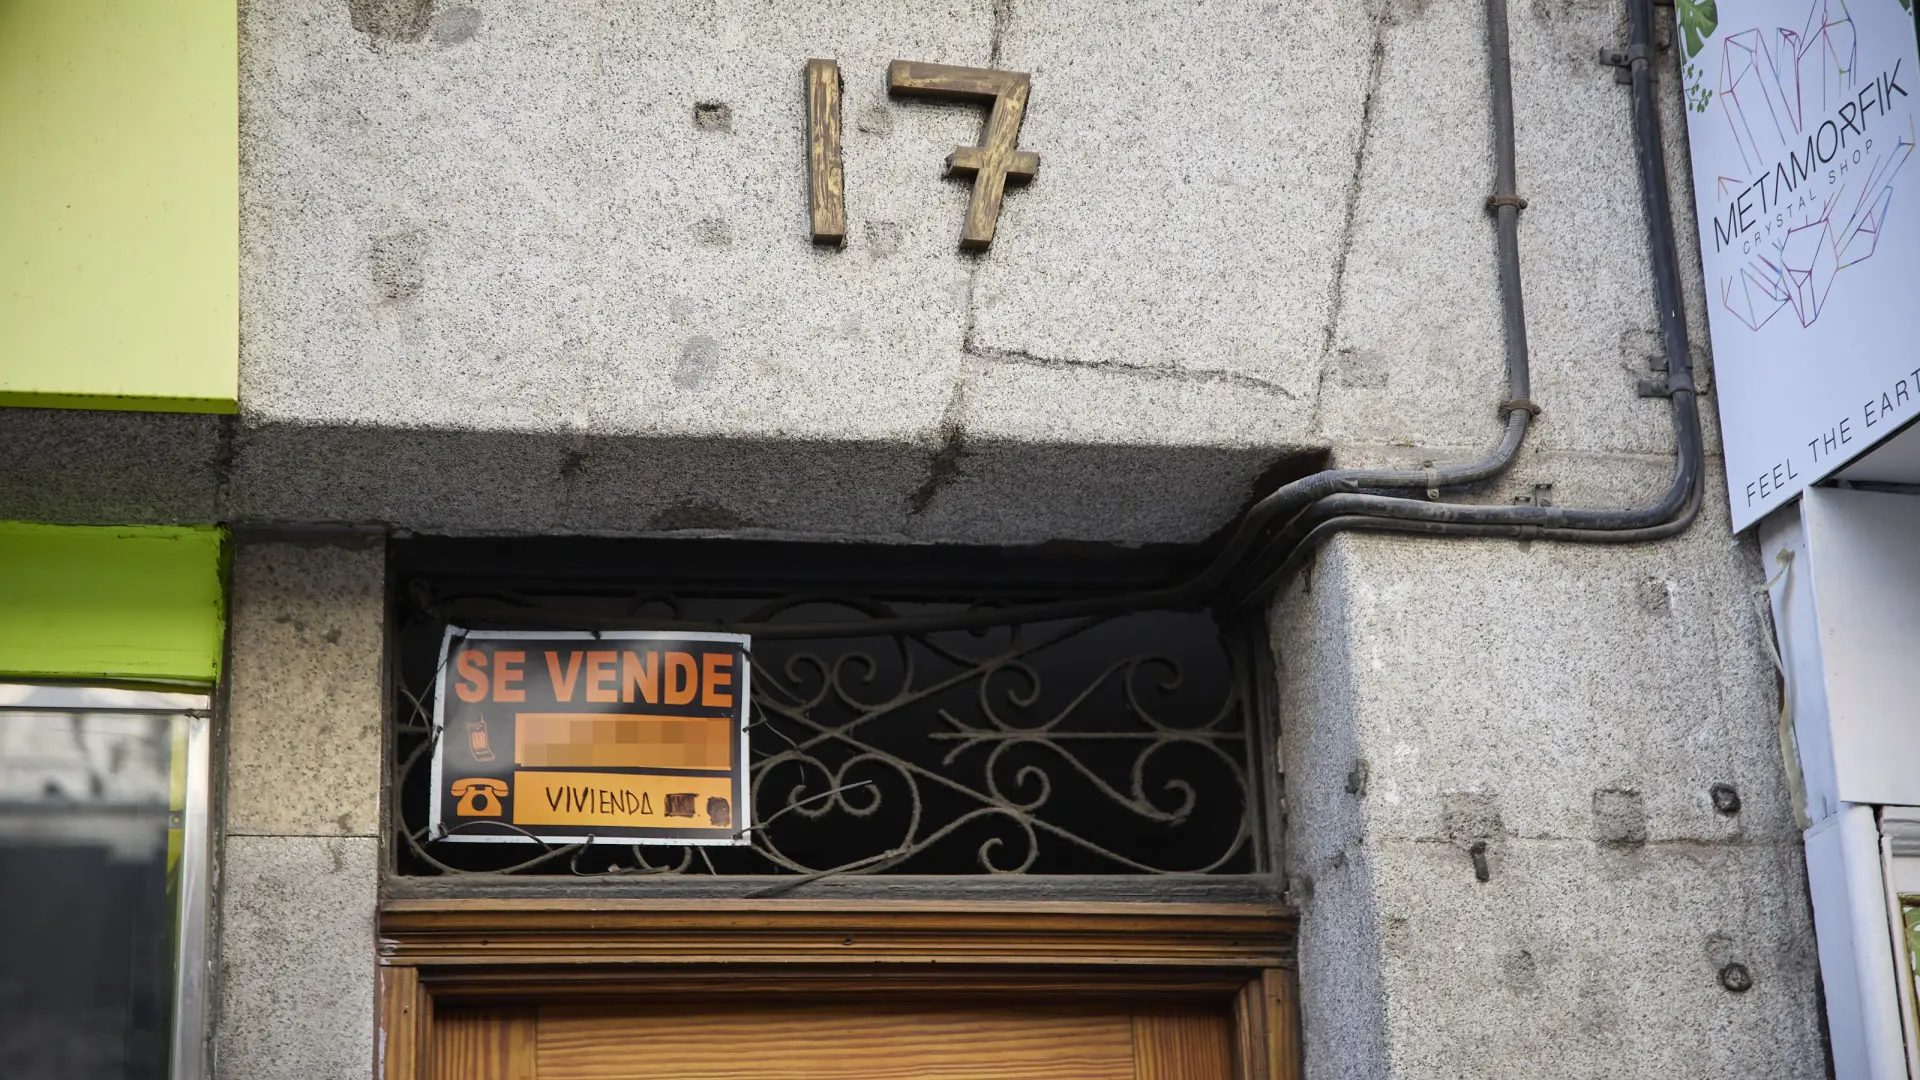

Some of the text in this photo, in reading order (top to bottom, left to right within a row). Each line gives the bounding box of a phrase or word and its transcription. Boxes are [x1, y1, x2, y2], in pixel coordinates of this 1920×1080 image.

[808, 57, 1041, 250] 17
[1713, 57, 1909, 254] METAMORFIK
[1743, 138, 1873, 255] CRYSTAL SHOP
[1746, 457, 1799, 508] FEEL
[1808, 416, 1852, 463] THE
[454, 649, 733, 708] SE VENDE
[545, 785, 654, 816] VIVIENDA
